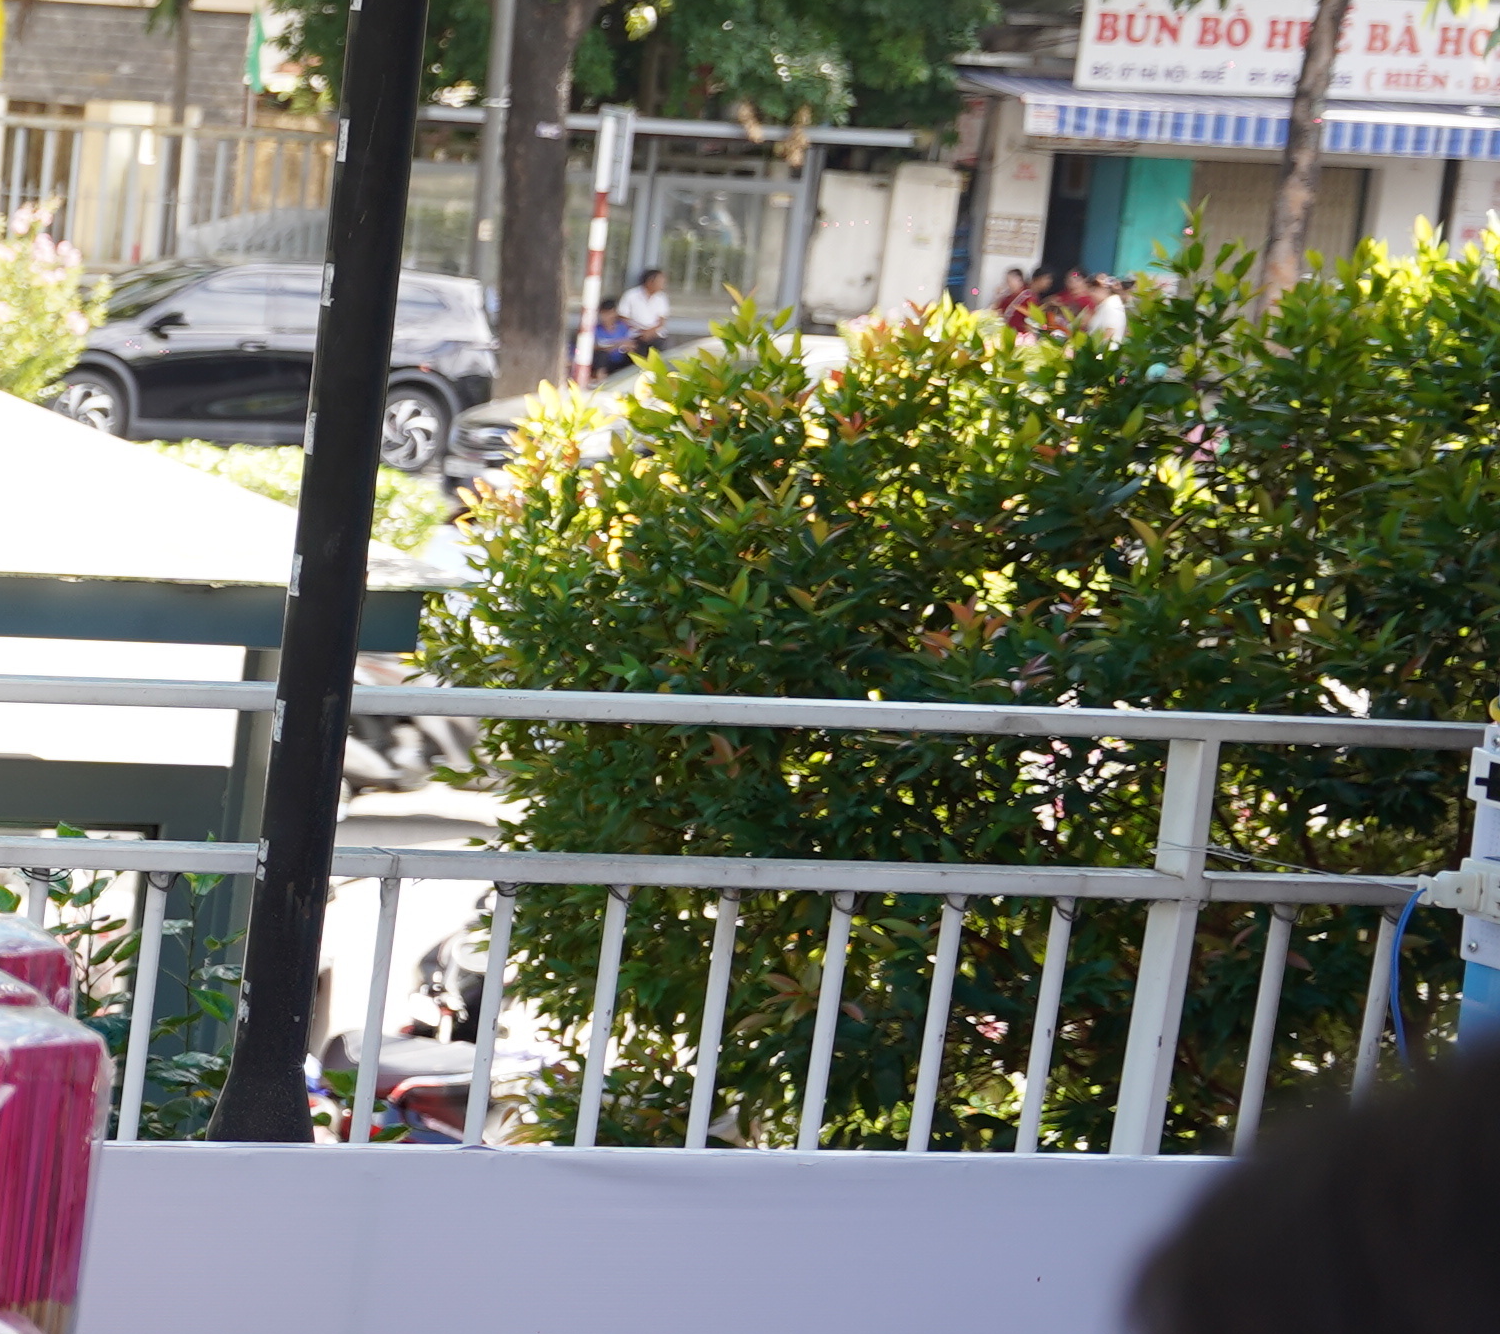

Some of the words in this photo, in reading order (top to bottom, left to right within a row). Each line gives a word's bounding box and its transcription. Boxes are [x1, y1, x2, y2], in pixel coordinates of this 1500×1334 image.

[1094, 2, 1183, 46] BÚN
[1197, 7, 1252, 47] BÒ
[1366, 13, 1420, 54] BÀ
[1437, 27, 1500, 58] HO
